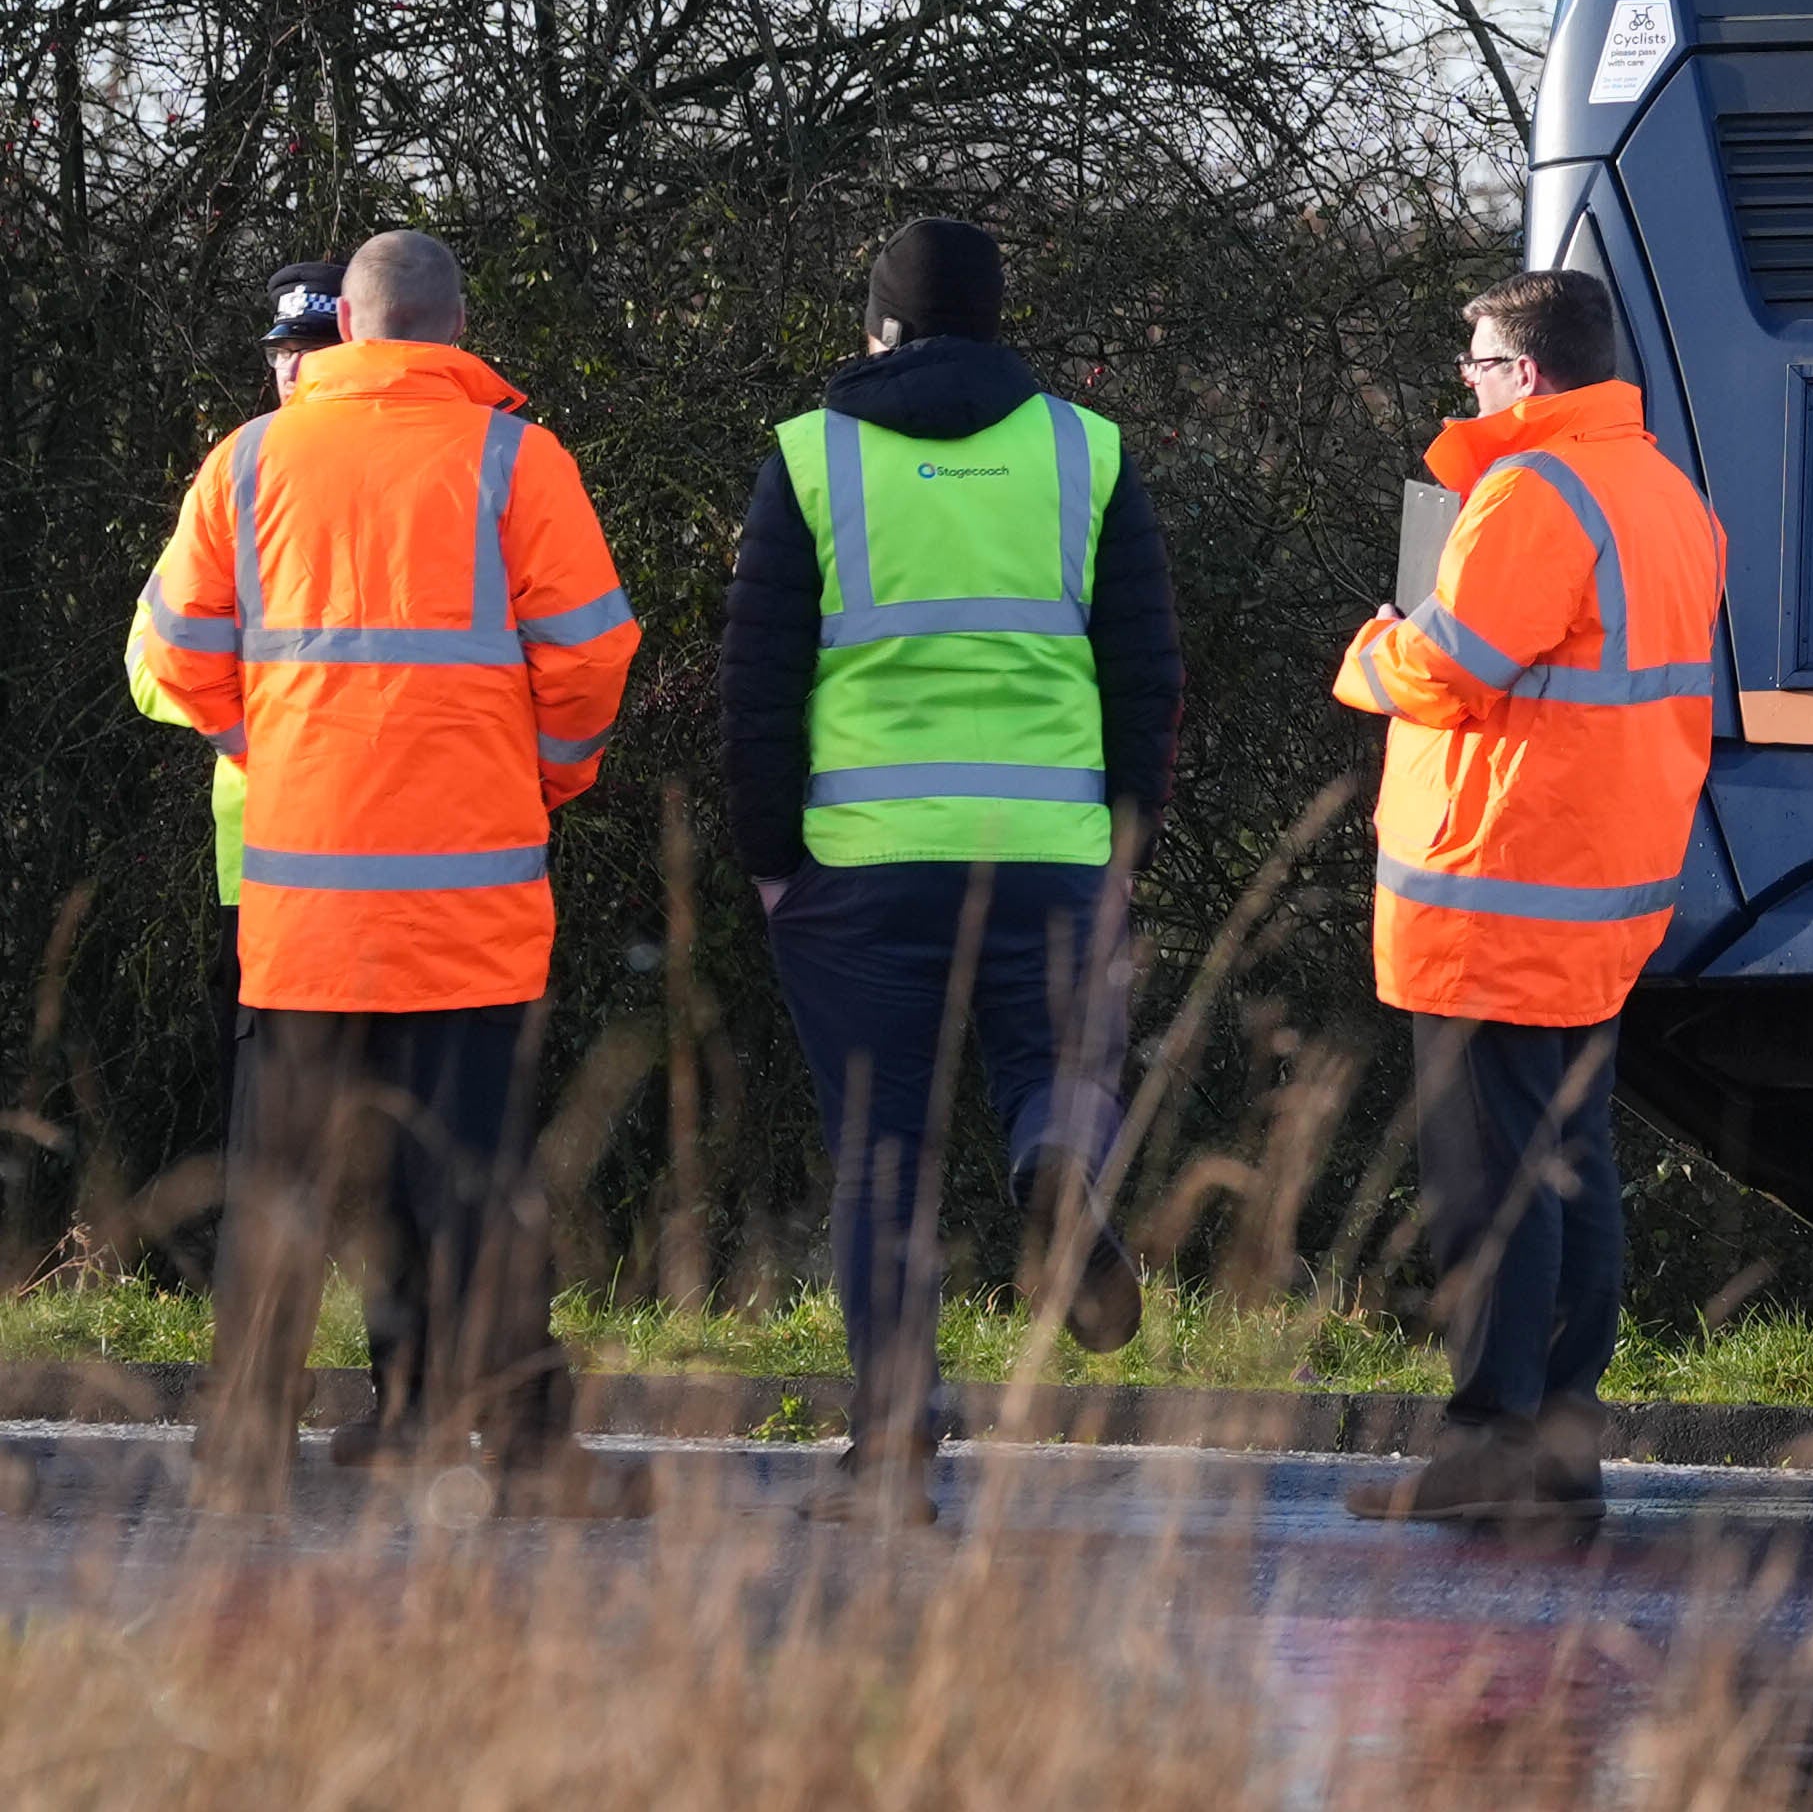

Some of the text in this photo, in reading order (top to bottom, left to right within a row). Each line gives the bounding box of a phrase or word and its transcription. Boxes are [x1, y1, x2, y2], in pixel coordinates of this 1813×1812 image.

[1613, 32, 1667, 47] Cyclists
[1611, 49, 1637, 57] please
[937, 465, 1010, 479] Stagecoach
